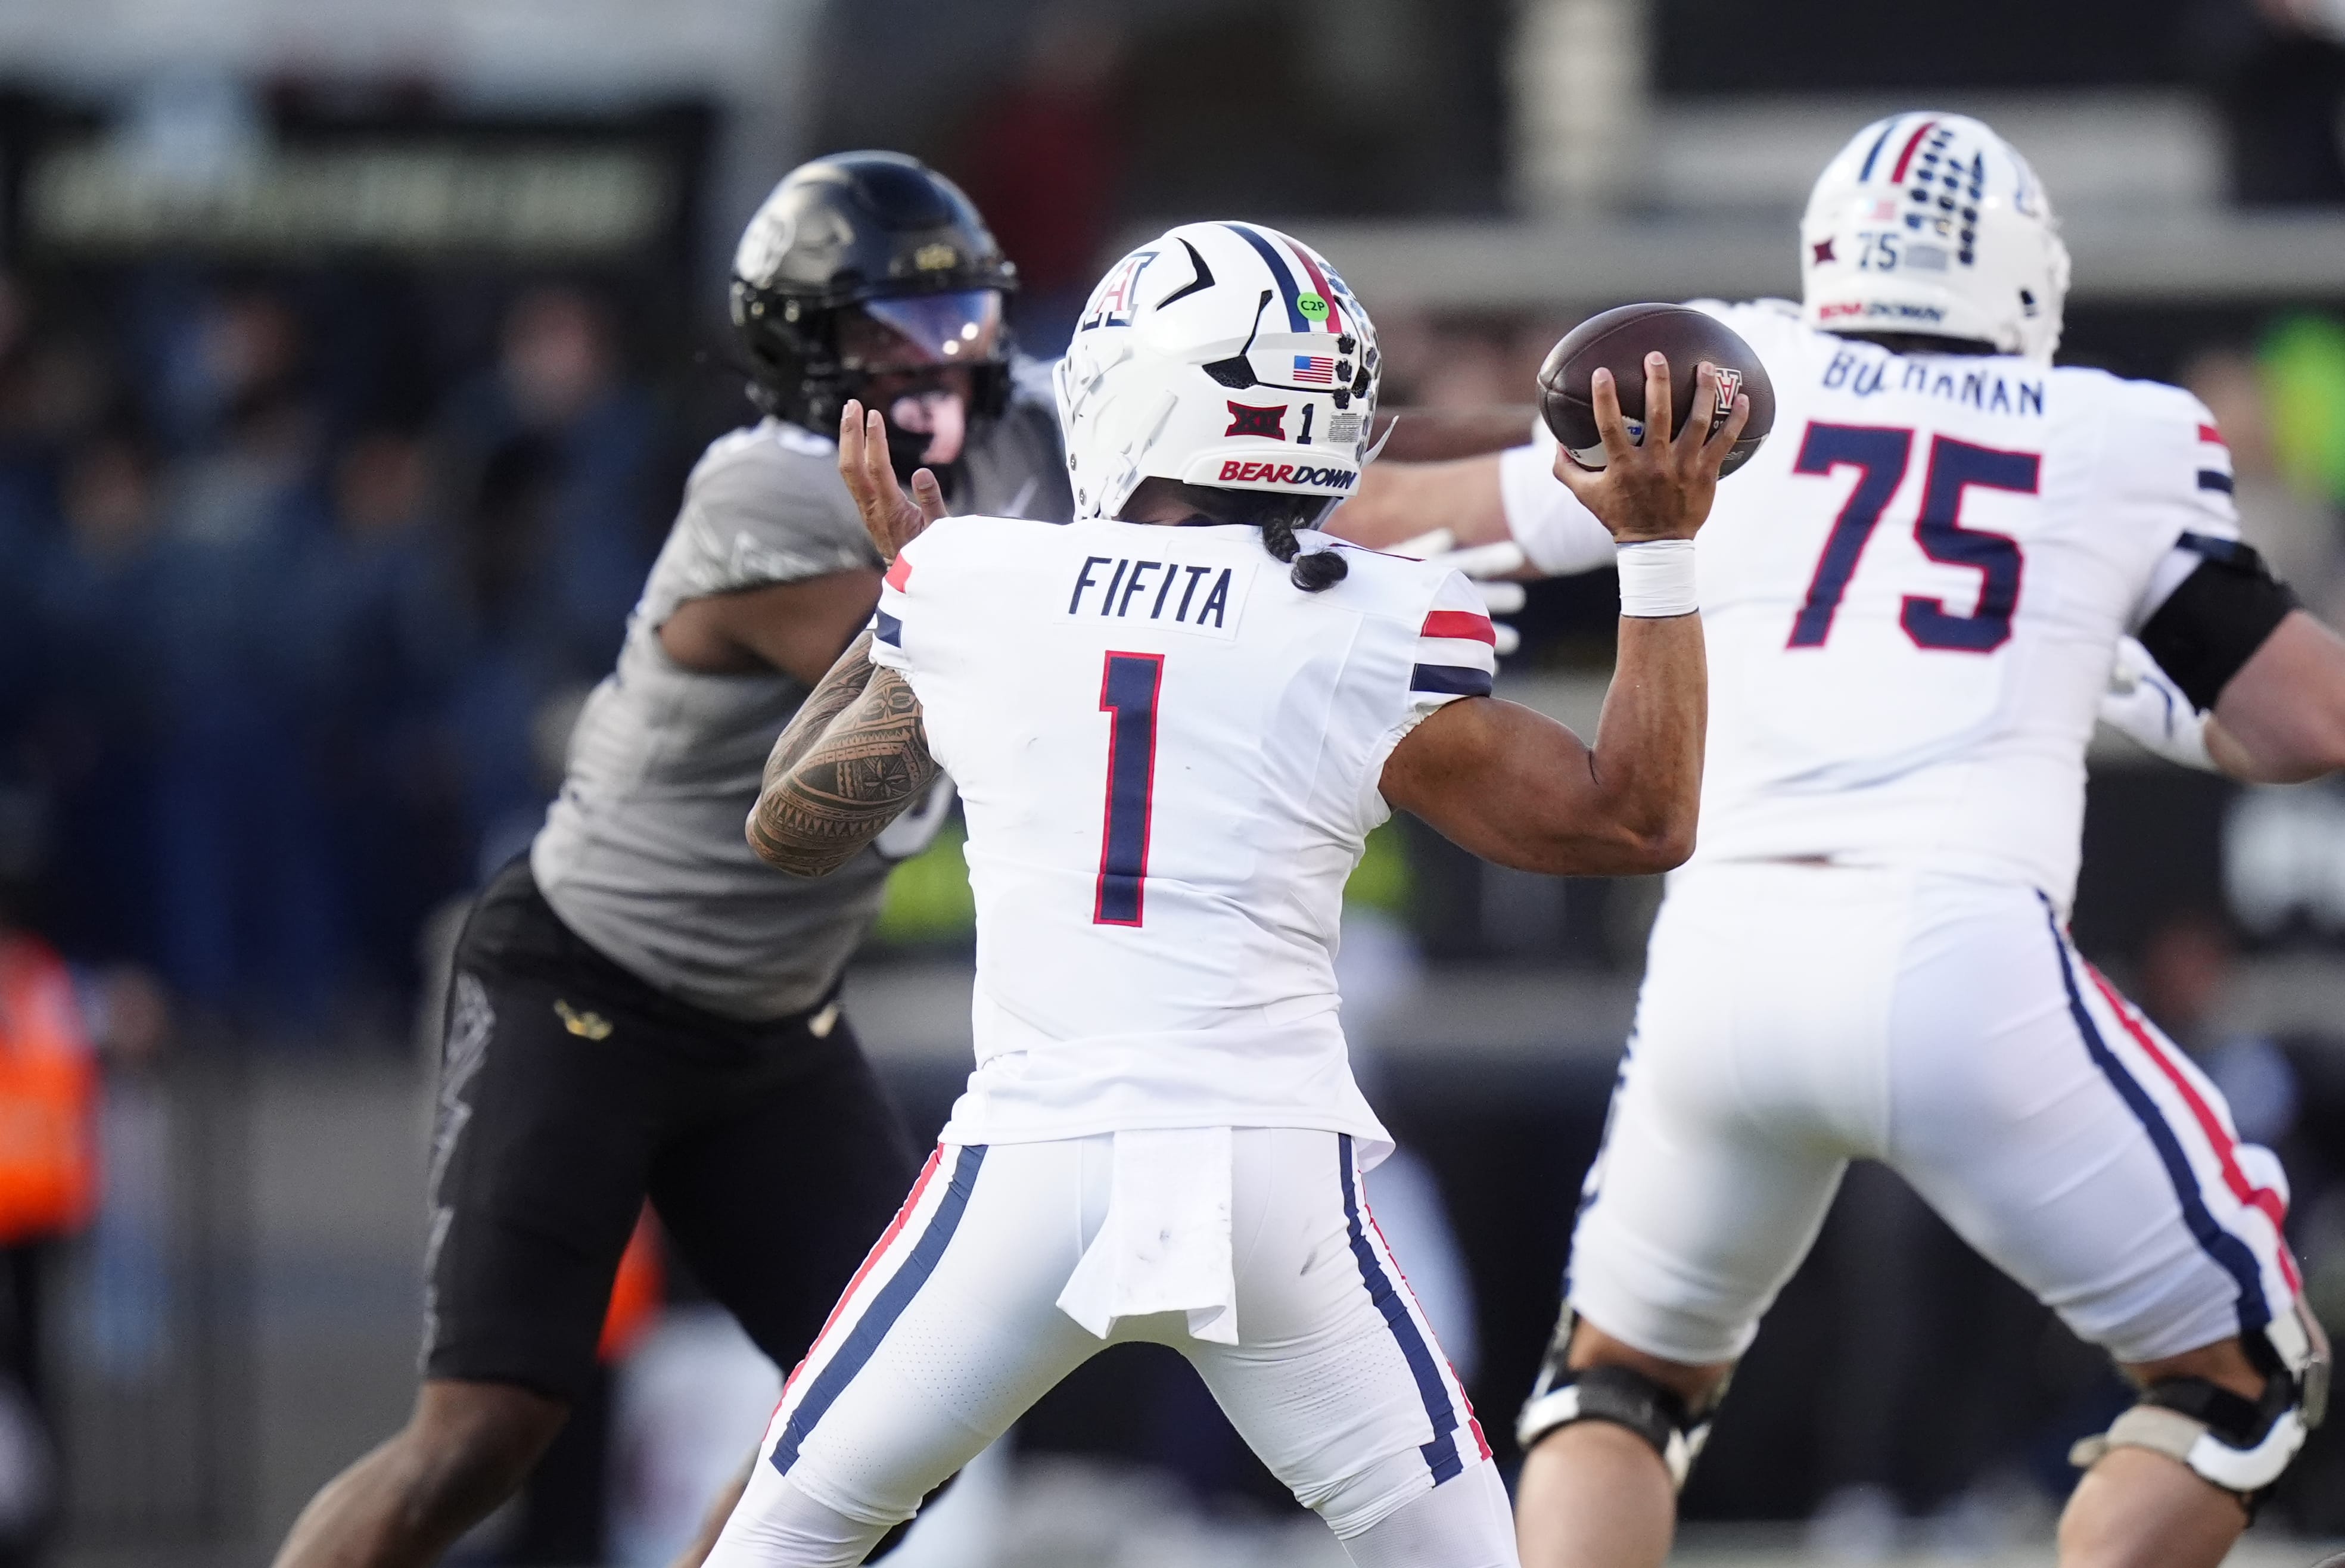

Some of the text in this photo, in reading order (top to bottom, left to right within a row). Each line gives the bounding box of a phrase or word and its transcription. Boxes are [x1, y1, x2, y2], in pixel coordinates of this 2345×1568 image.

[1858, 232, 1899, 271] 75
[1301, 300, 1324, 311] C2P
[1823, 350, 2043, 415] BUHANAN
[1296, 403, 1314, 444] 1
[1785, 420, 2041, 653] 75
[1069, 556, 1231, 628] FIFITA
[1093, 650, 1165, 928] 1
